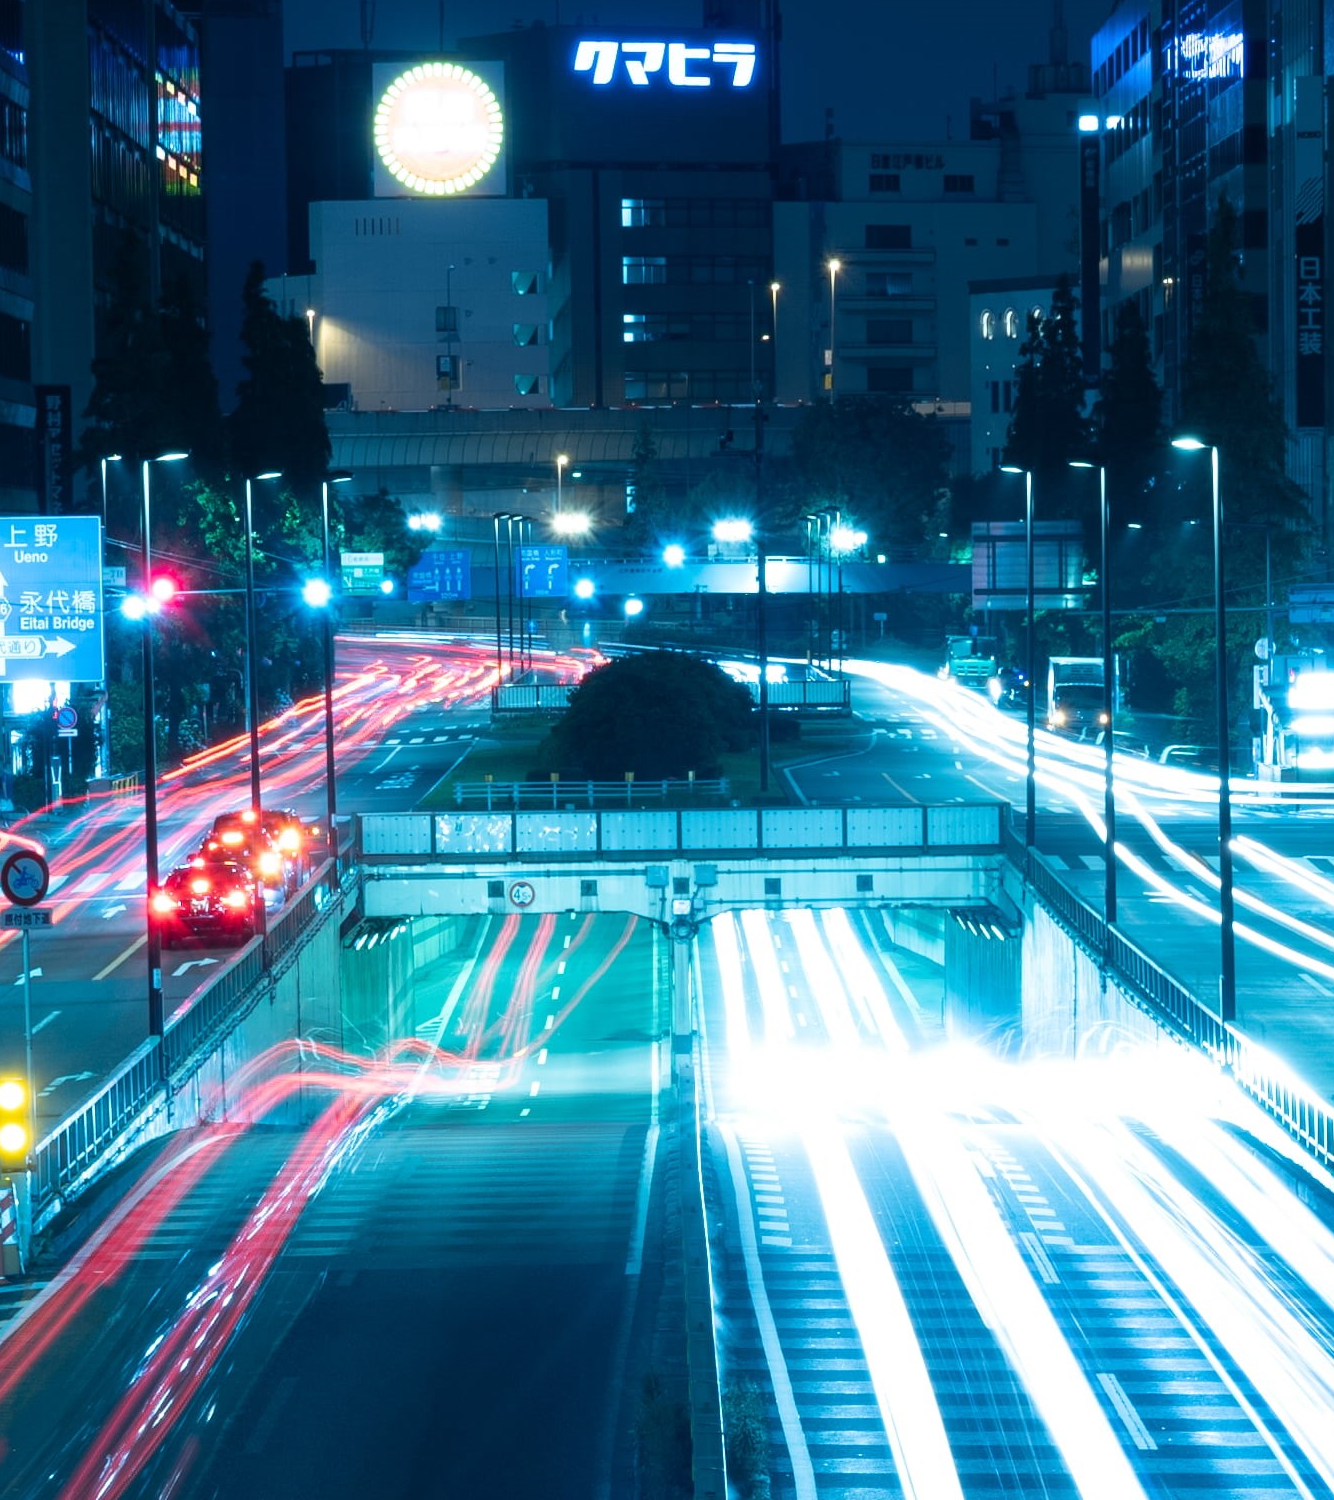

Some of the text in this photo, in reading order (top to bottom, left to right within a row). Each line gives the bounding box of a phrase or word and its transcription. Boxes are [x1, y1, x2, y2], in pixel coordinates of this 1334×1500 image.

[573, 40, 757, 88] クマヒラ
[1298, 257, 1323, 356] 日本工装
[4, 524, 59, 548] 上野
[14, 550, 48, 563] Ueno
[19, 590, 96, 614] 永代橋
[20, 616, 95, 631] Eitai Bridge
